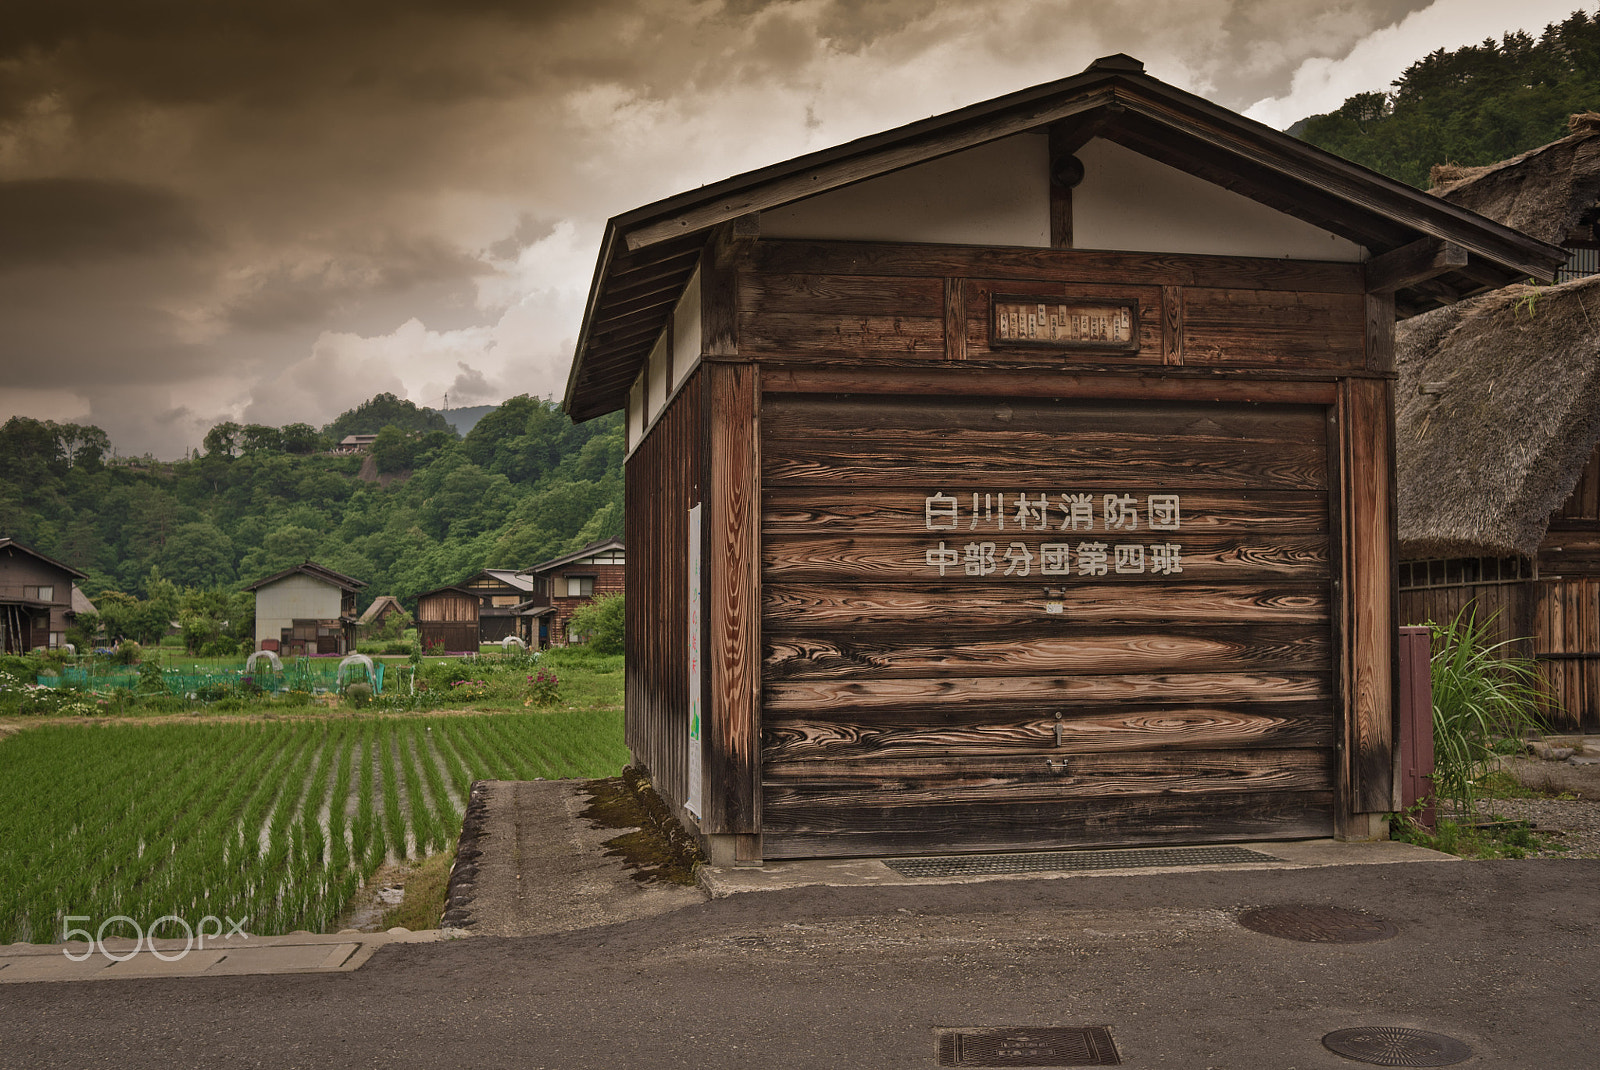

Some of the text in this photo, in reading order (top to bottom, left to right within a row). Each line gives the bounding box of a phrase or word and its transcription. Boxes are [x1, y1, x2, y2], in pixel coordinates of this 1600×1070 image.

[925, 491, 1181, 531] 白川村消防団
[925, 541, 1183, 577] 中部分団第四班
